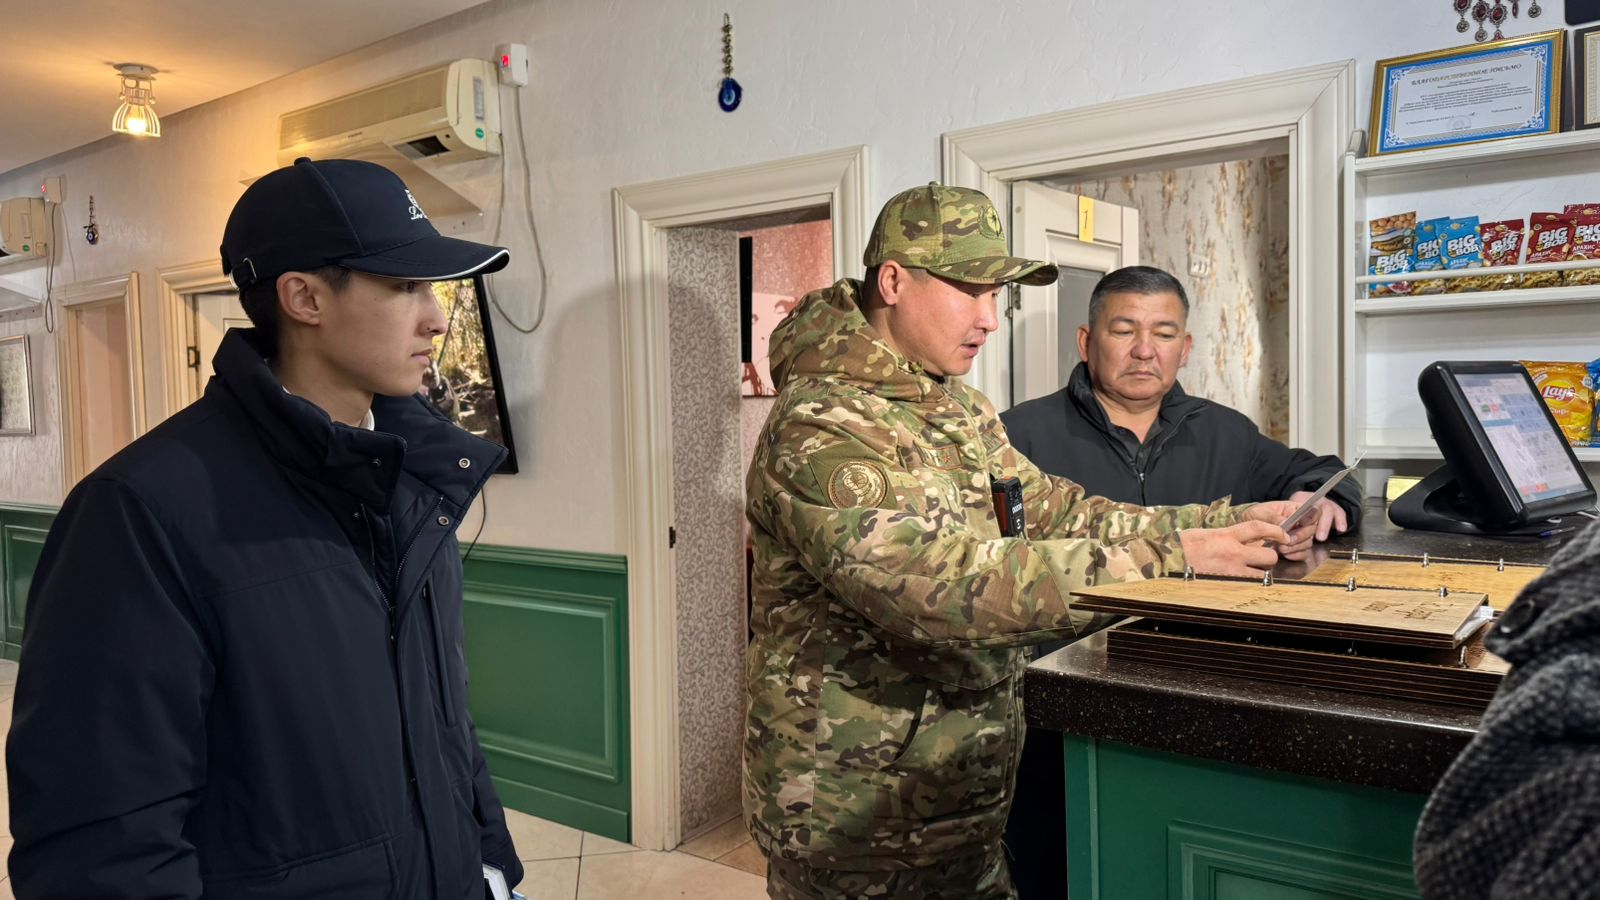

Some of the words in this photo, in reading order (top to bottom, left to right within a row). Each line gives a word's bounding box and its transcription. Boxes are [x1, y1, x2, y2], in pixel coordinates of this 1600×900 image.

[1538, 227, 1568, 243] BIG
[1583, 234, 1600, 243] BO
[1448, 234, 1475, 251] BIG
[1456, 243, 1479, 256] BOB
[1377, 249, 1406, 267] BIG
[1425, 248, 1439, 259] BO
